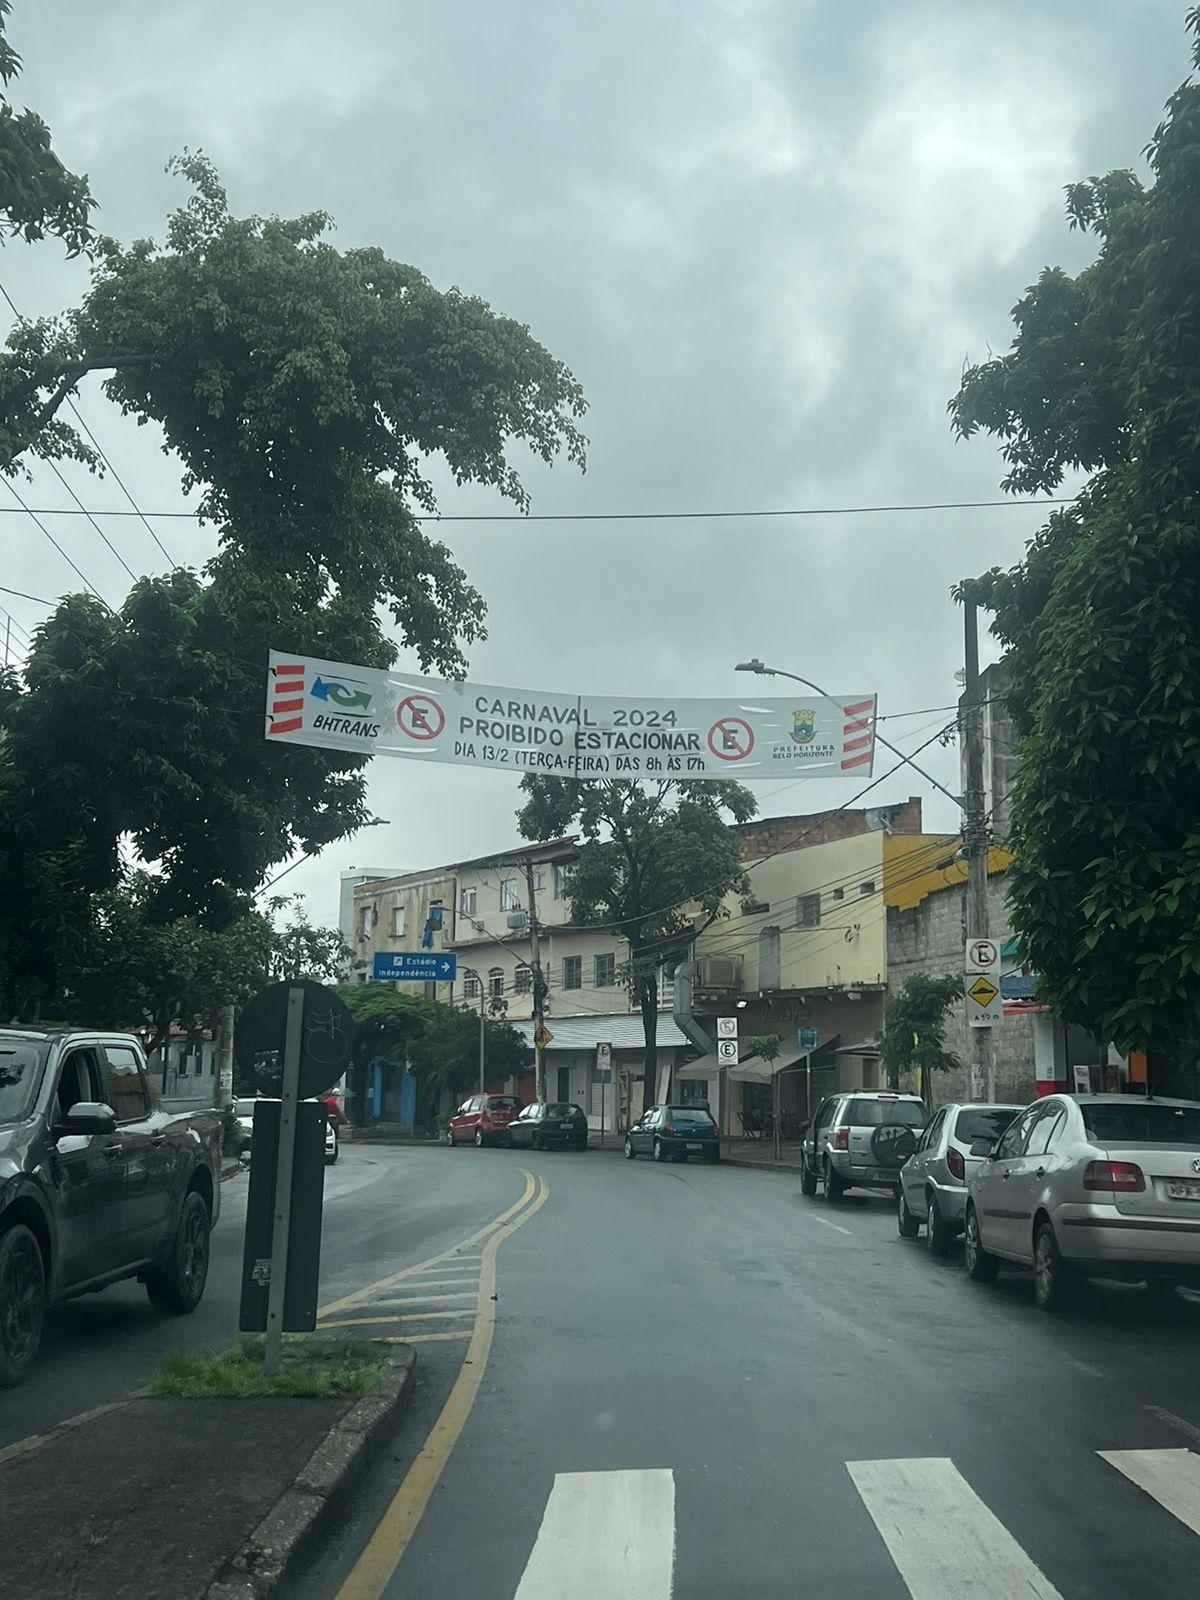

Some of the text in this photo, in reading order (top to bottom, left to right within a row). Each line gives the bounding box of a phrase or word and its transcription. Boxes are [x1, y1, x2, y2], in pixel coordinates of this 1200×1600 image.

[475, 696, 678, 727] CARNAVAL 2024
[313, 714, 381, 738] BHTRANS
[460, 716, 700, 751] PROIBIDO ESTACIONAR
[454, 740, 476, 758] DIA
[482, 745, 509, 762] 13/2
[515, 750, 610, 772] (TERÇA-FEIRA)
[615, 756, 640, 771] DAS
[645, 756, 662, 771] 8h
[687, 757, 705, 771] 17h
[773, 744, 835, 753] PREFEITURA
[406, 956, 437, 966] Estádio
[378, 969, 437, 977] Independência
[724, 1044, 731, 1055] E
